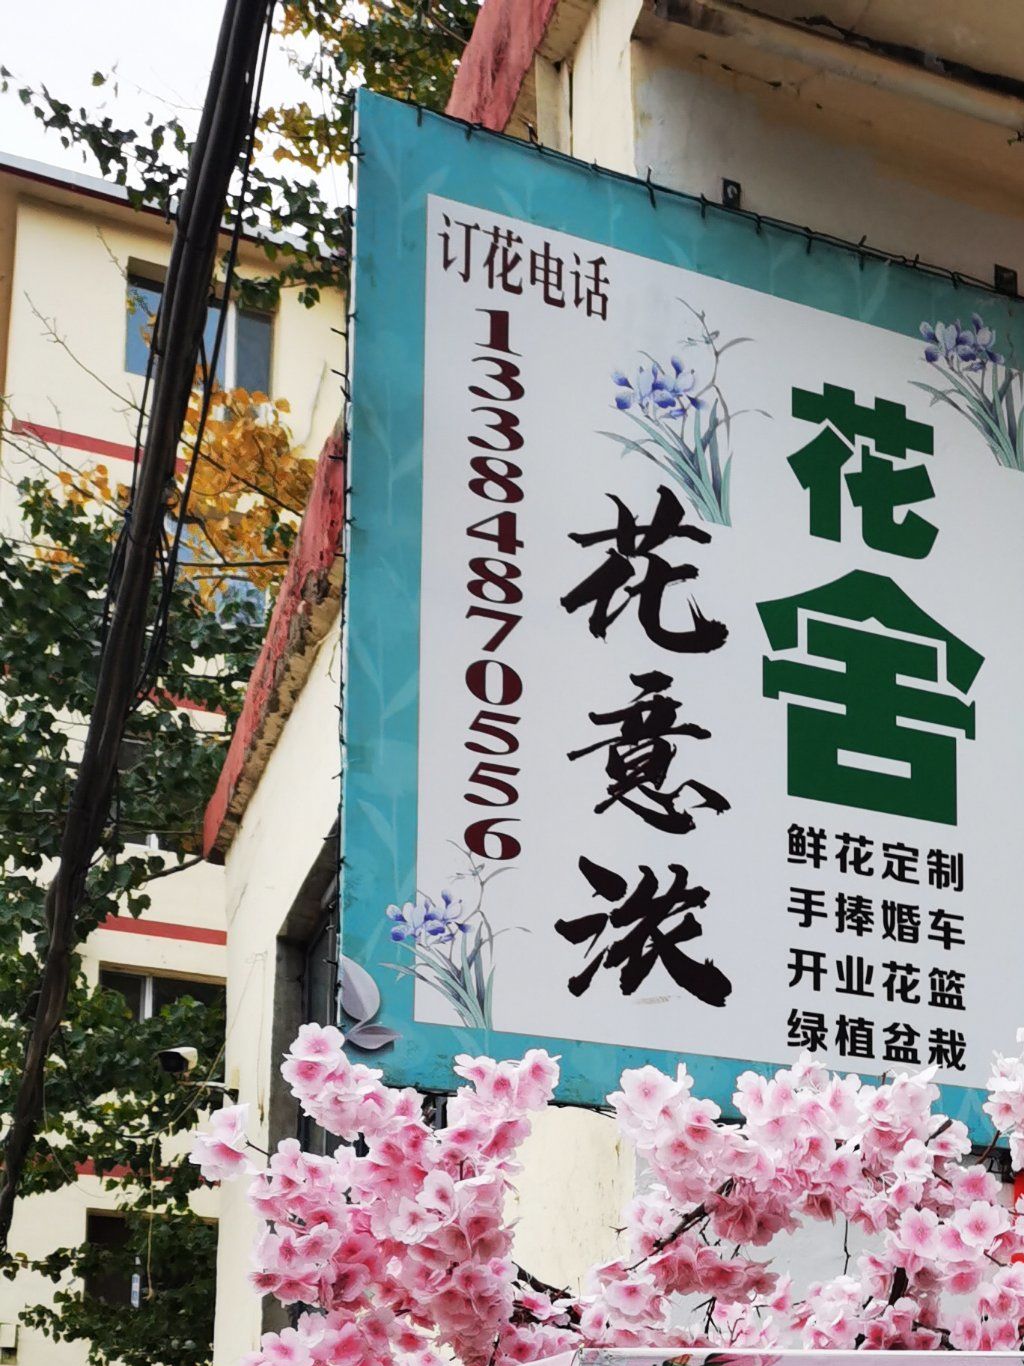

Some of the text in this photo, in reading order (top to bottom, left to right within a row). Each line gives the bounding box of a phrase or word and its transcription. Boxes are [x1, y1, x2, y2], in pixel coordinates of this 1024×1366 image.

[436, 213, 611, 322] 订花电话
[463, 308, 526, 861] 13384870556
[755, 381, 986, 827] 花舍
[553, 484, 734, 1008] 花意浓
[787, 822, 966, 893] 鲜花定制
[787, 886, 967, 953] 手捧婚车
[787, 947, 968, 1012] 开业花篮
[787, 1007, 969, 1072] 绿植盆栽
